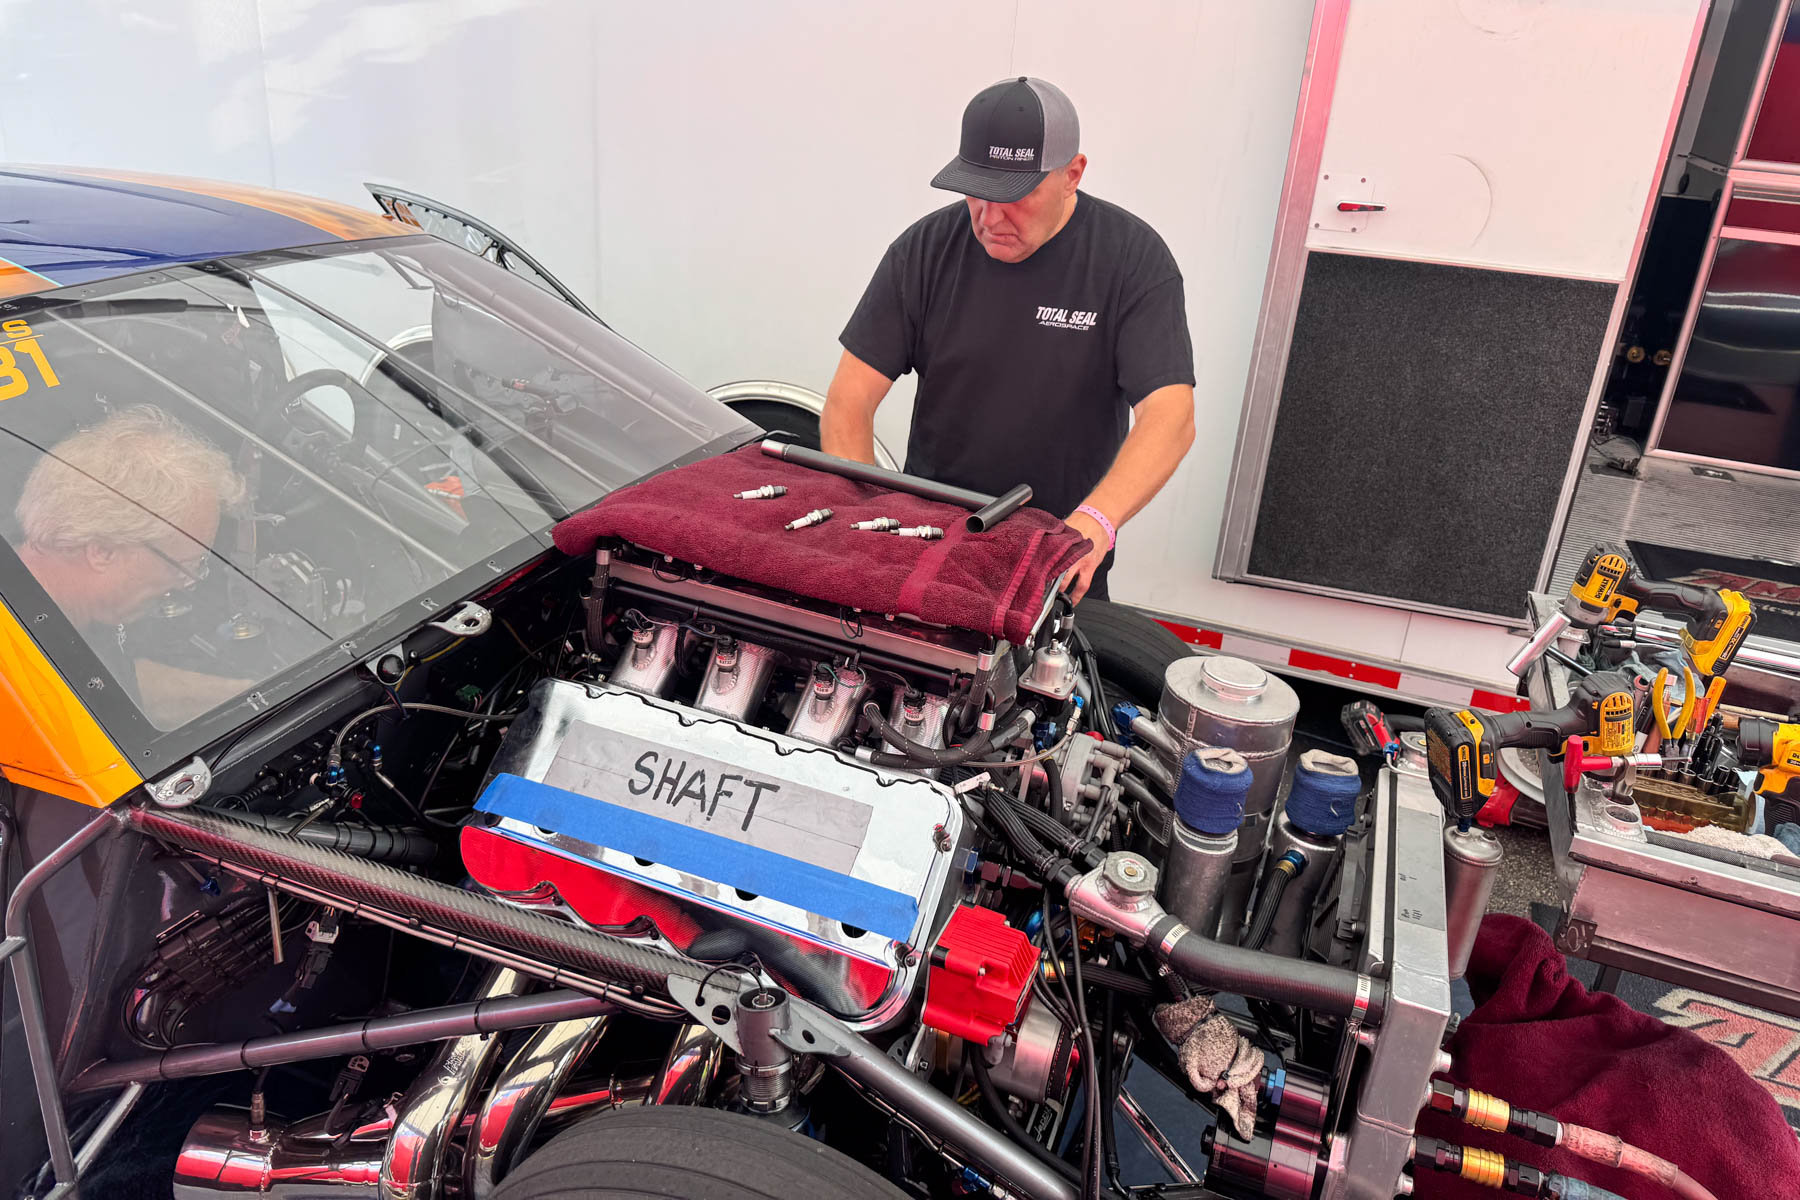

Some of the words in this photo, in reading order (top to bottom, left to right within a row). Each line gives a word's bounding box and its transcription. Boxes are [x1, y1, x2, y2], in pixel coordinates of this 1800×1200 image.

[988, 145, 1014, 158] TOTAL
[1014, 148, 1035, 158] SEAL
[1035, 306, 1069, 323] TOTAL
[1068, 310, 1098, 326] SEAL
[1038, 320, 1090, 331] AEROSPACE
[628, 751, 781, 832] SHAFT
